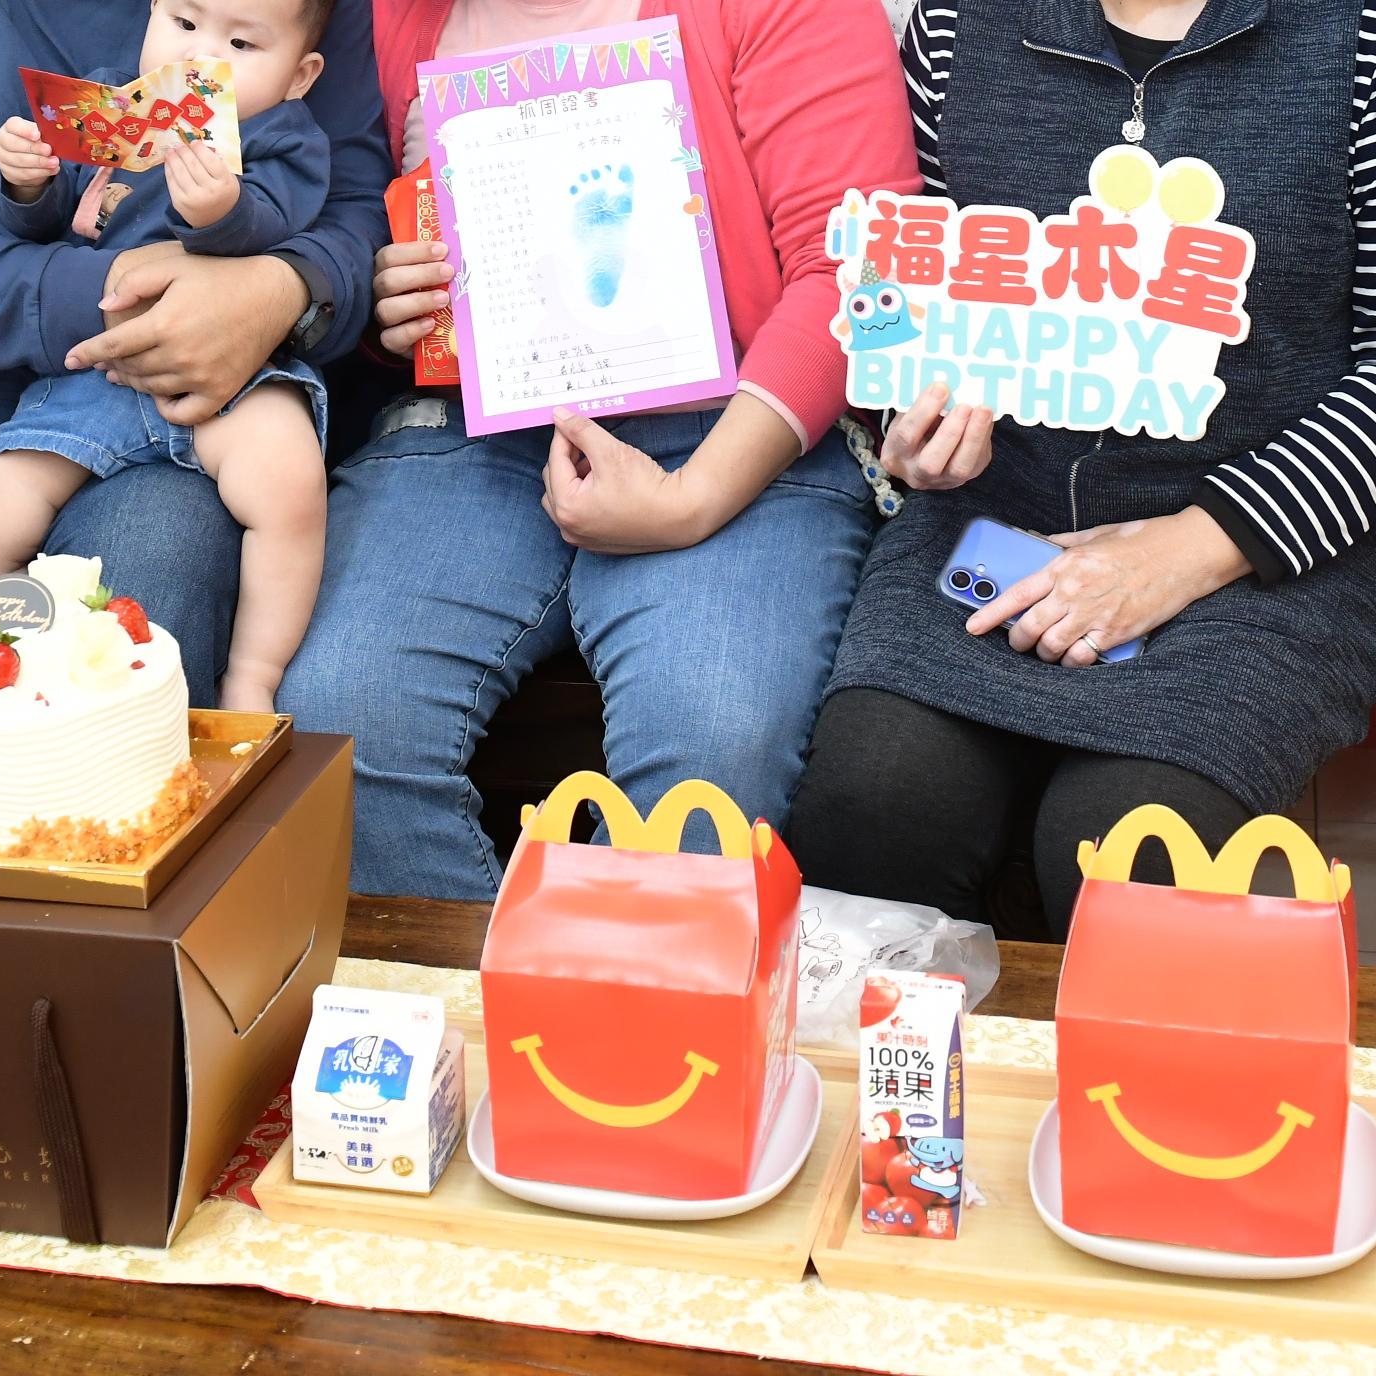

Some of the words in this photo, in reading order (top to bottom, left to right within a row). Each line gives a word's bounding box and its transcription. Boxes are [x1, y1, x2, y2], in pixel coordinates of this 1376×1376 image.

[519, 91, 598, 120] 抓周證書
[866, 199, 1247, 337] 福星本星
[926, 301, 1170, 374] HAPPY
[853, 351, 1215, 436] BIRTHDAY
[333, 1049, 401, 1076] 乳家
[869, 1046, 934, 1071] 100%
[869, 1068, 934, 1101] 蘋果
[330, 1112, 388, 1125] 高品質純鮮乳
[338, 1124, 359, 1132] Fresh
[362, 1125, 379, 1133] Milk
[346, 1141, 372, 1152] 美味
[347, 1155, 373, 1168] 首選
